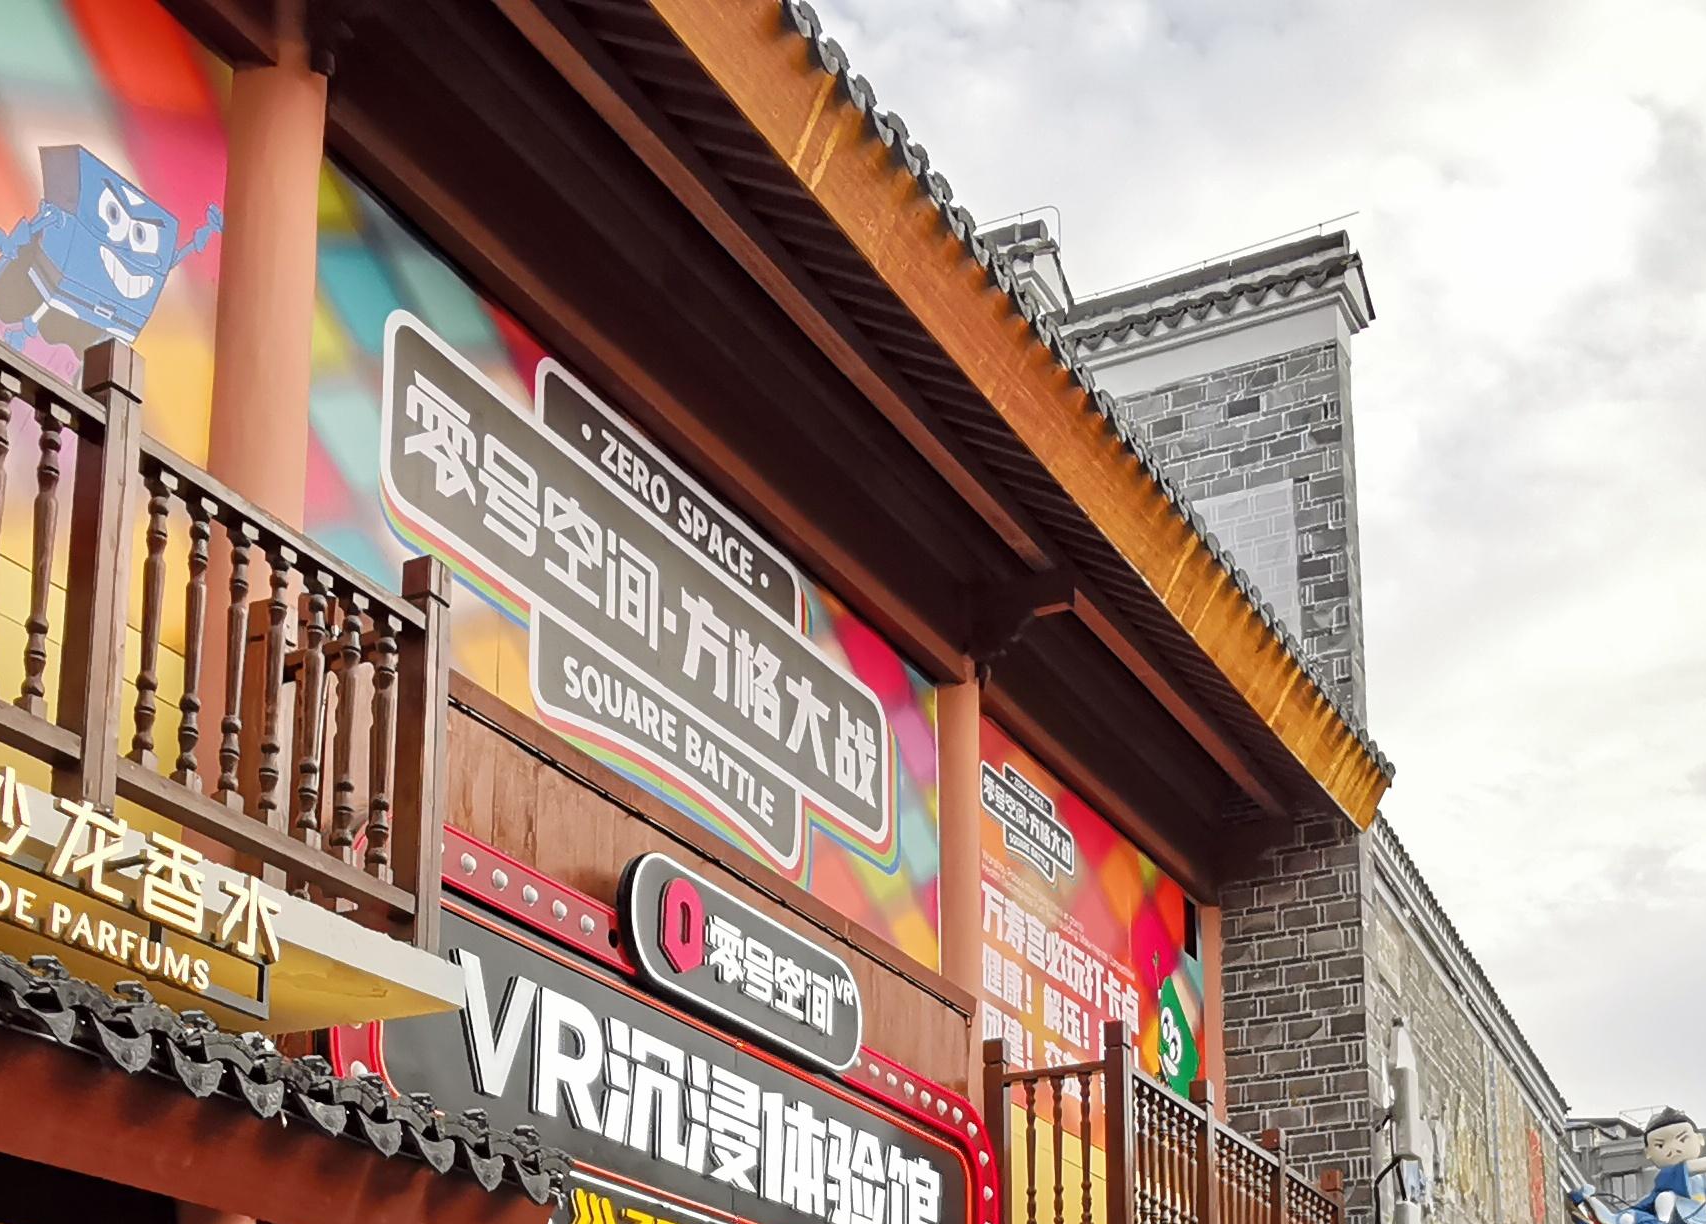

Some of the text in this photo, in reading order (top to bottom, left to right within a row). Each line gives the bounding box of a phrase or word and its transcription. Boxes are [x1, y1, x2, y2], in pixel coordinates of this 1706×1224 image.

[600, 428, 753, 587] ZERO SPACE
[405, 370, 877, 809] 零号空间·方格大战
[563, 656, 775, 827] SQUARE BATTLE
[50, 900, 212, 992] PARFUMS
[703, 912, 855, 1035] 零号空间 VR
